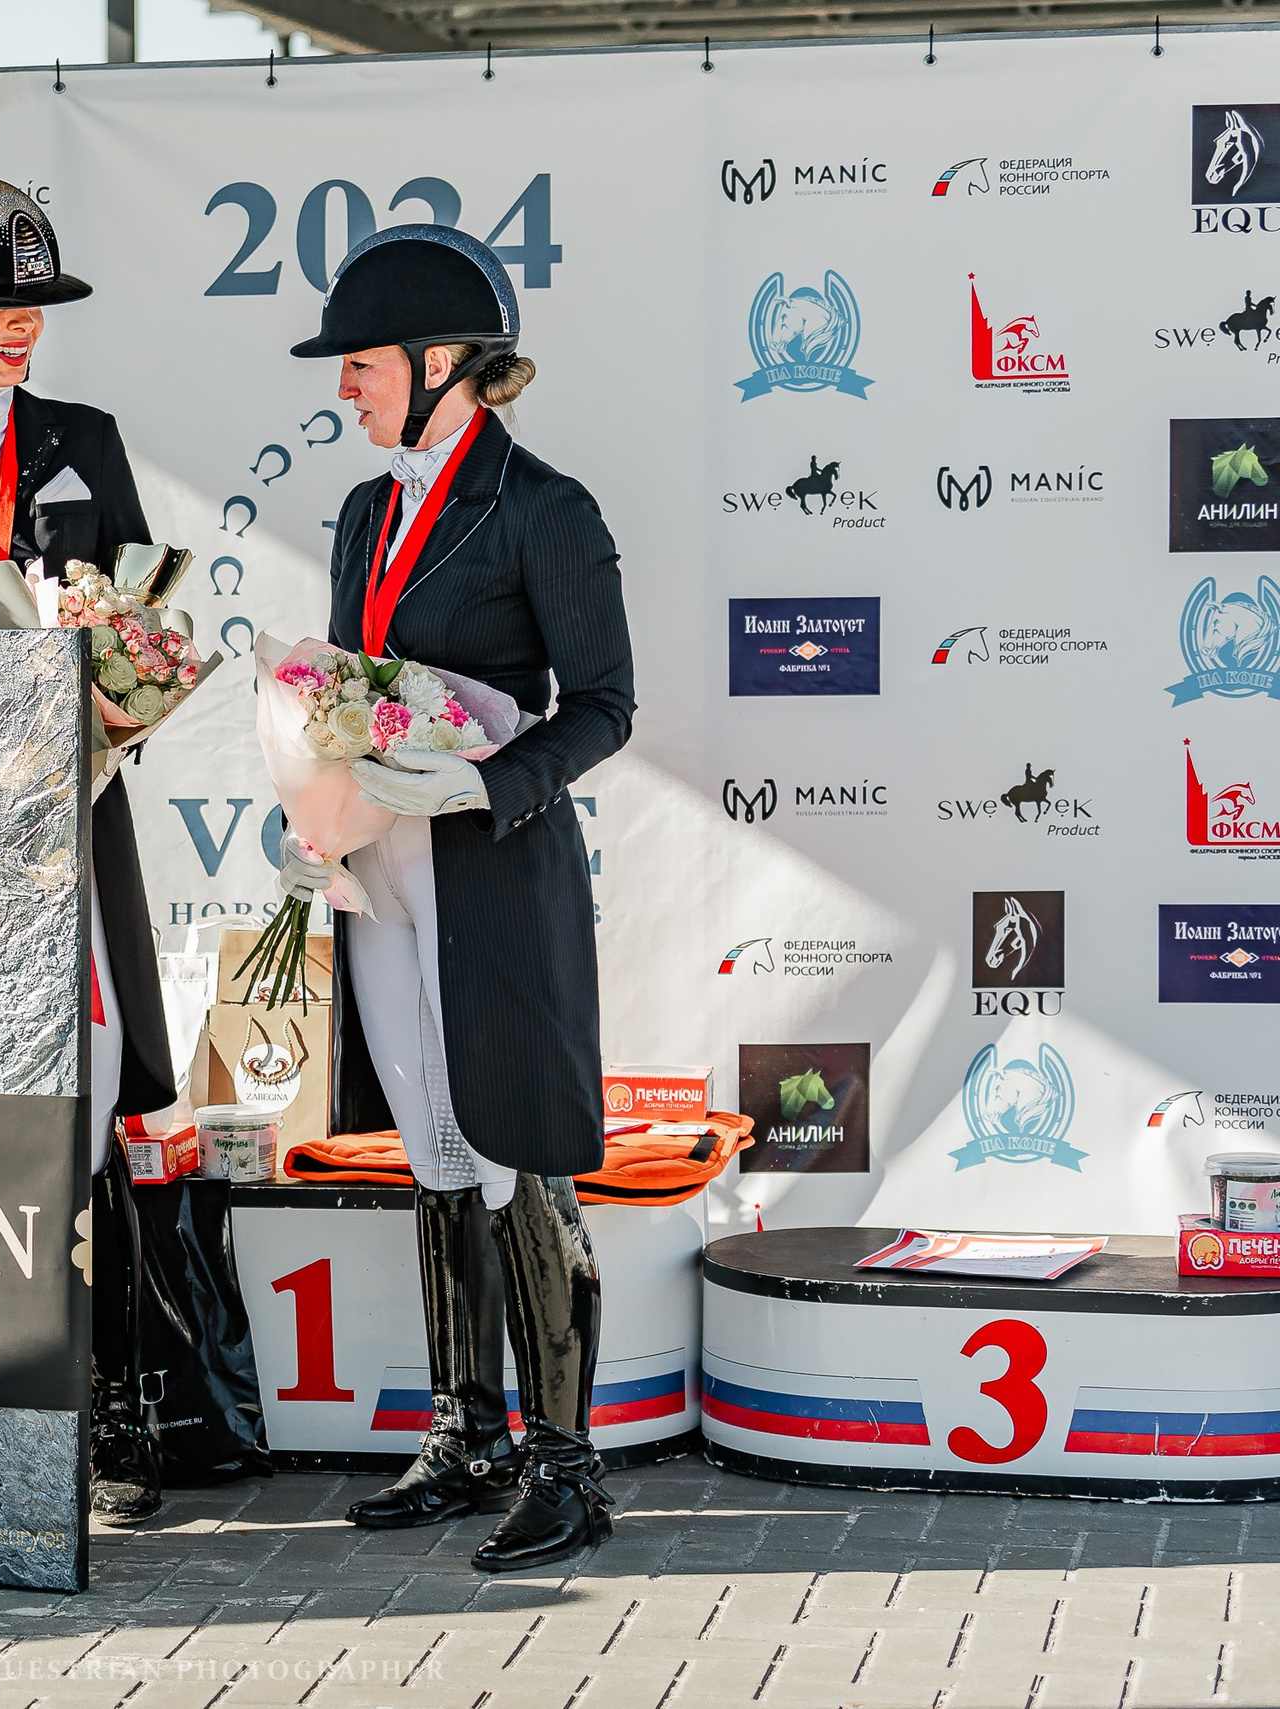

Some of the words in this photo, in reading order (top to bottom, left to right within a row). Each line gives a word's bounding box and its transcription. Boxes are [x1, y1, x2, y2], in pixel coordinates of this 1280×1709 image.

[999, 157, 1072, 170] ФЕДЕРАЦИЯ
[999, 171, 1059, 183] КОННОГО
[1061, 169, 1110, 181] СПОРТА
[823, 188, 864, 196] EQUESTRIAN
[999, 184, 1050, 196] РОССИИ
[996, 354, 1065, 372] ФКСМ
[766, 367, 791, 383] НА
[794, 365, 842, 383] КОНЕ
[1197, 503, 1278, 520] АНИЛИН
[833, 516, 886, 528] Product
[999, 628, 1070, 640] ФЕДЕРАЦИЯ
[999, 641, 1058, 652] КОННОГО
[1060, 640, 1108, 652] СПОРТА
[999, 654, 1049, 665] РОССИИ
[779, 664, 817, 672] ФАБРИКА
[1197, 672, 1223, 689] НА
[1225, 670, 1274, 689] КОНЕ
[1047, 824, 1100, 836] Product
[784, 940, 855, 952] ФЕДЕРАЦИЯ
[784, 953, 842, 964] КОННОГО
[846, 953, 893, 964] СПОРТА
[784, 966, 834, 976] РОССИИ
[1210, 971, 1248, 979] ФАБРИКА
[972, 990, 1065, 1016] EQU
[246, 1092, 289, 1102] ZABEGINA
[1214, 1094, 1280, 1106] ФЕДЕРАЦИ
[1215, 1106, 1274, 1118] КОННОГО
[1215, 1119, 1265, 1130] РОССИИ
[766, 1125, 844, 1142] АНИЛИН
[979, 1138, 1005, 1153] НА
[1008, 1137, 1057, 1155] КОНЕ
[271, 1258, 355, 1402] 1
[947, 1318, 1048, 1464] 3
[156, 1417, 203, 1430] EQU-CHOICE.RU
